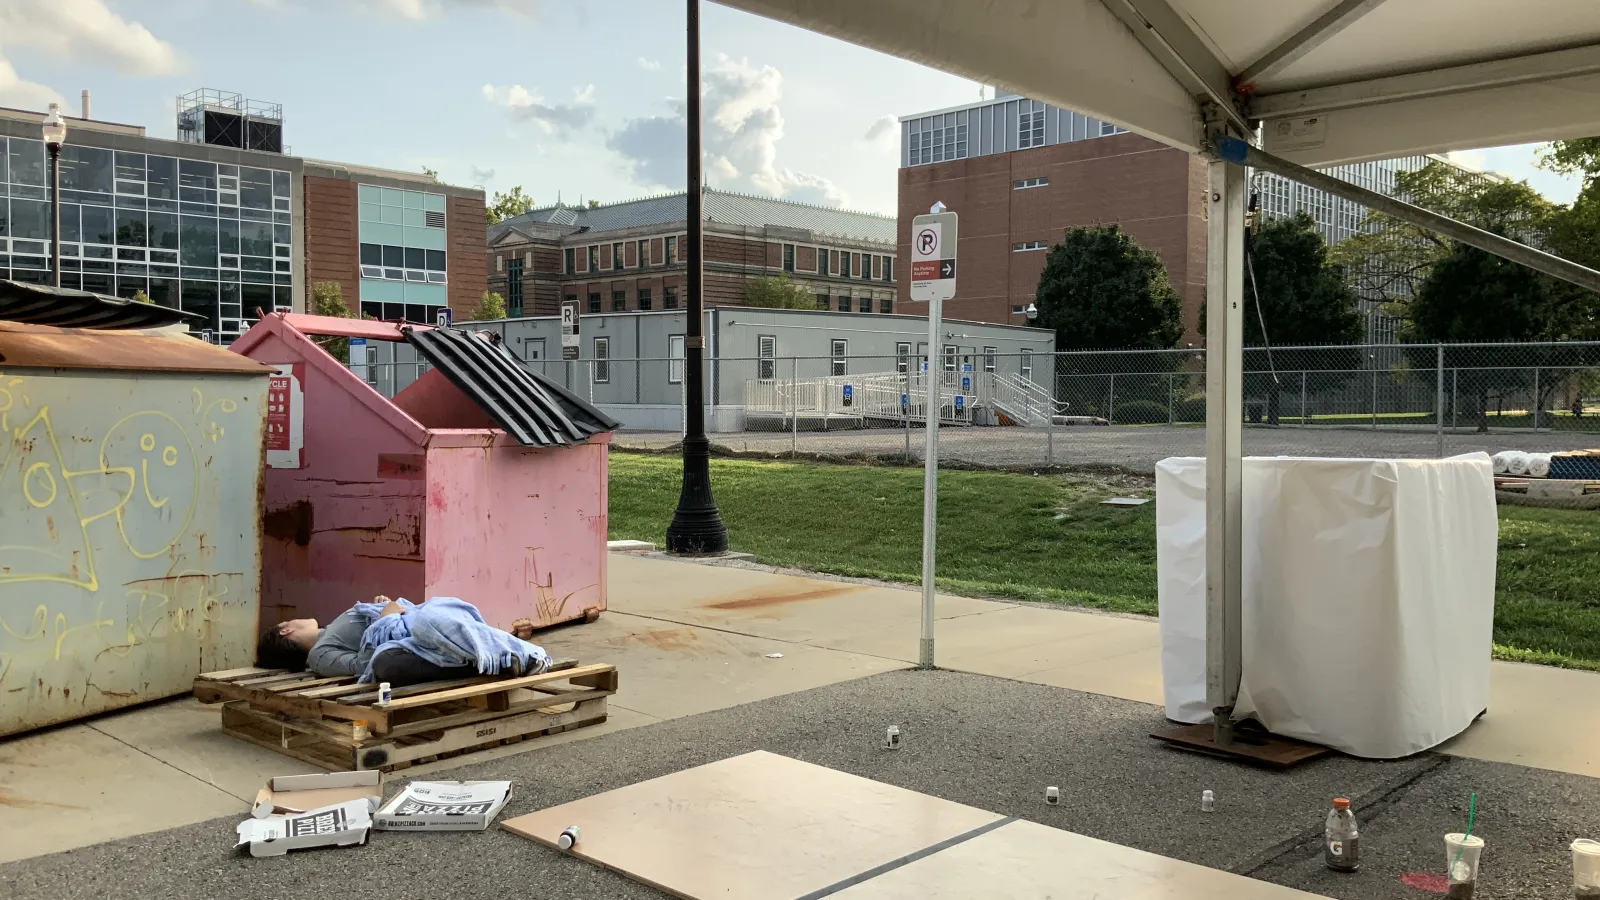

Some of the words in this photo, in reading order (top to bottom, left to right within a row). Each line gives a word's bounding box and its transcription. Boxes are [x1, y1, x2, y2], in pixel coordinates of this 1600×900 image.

[439, 315, 445, 326] D
[564, 309, 572, 322] R
[1330, 841, 1342, 856] G
